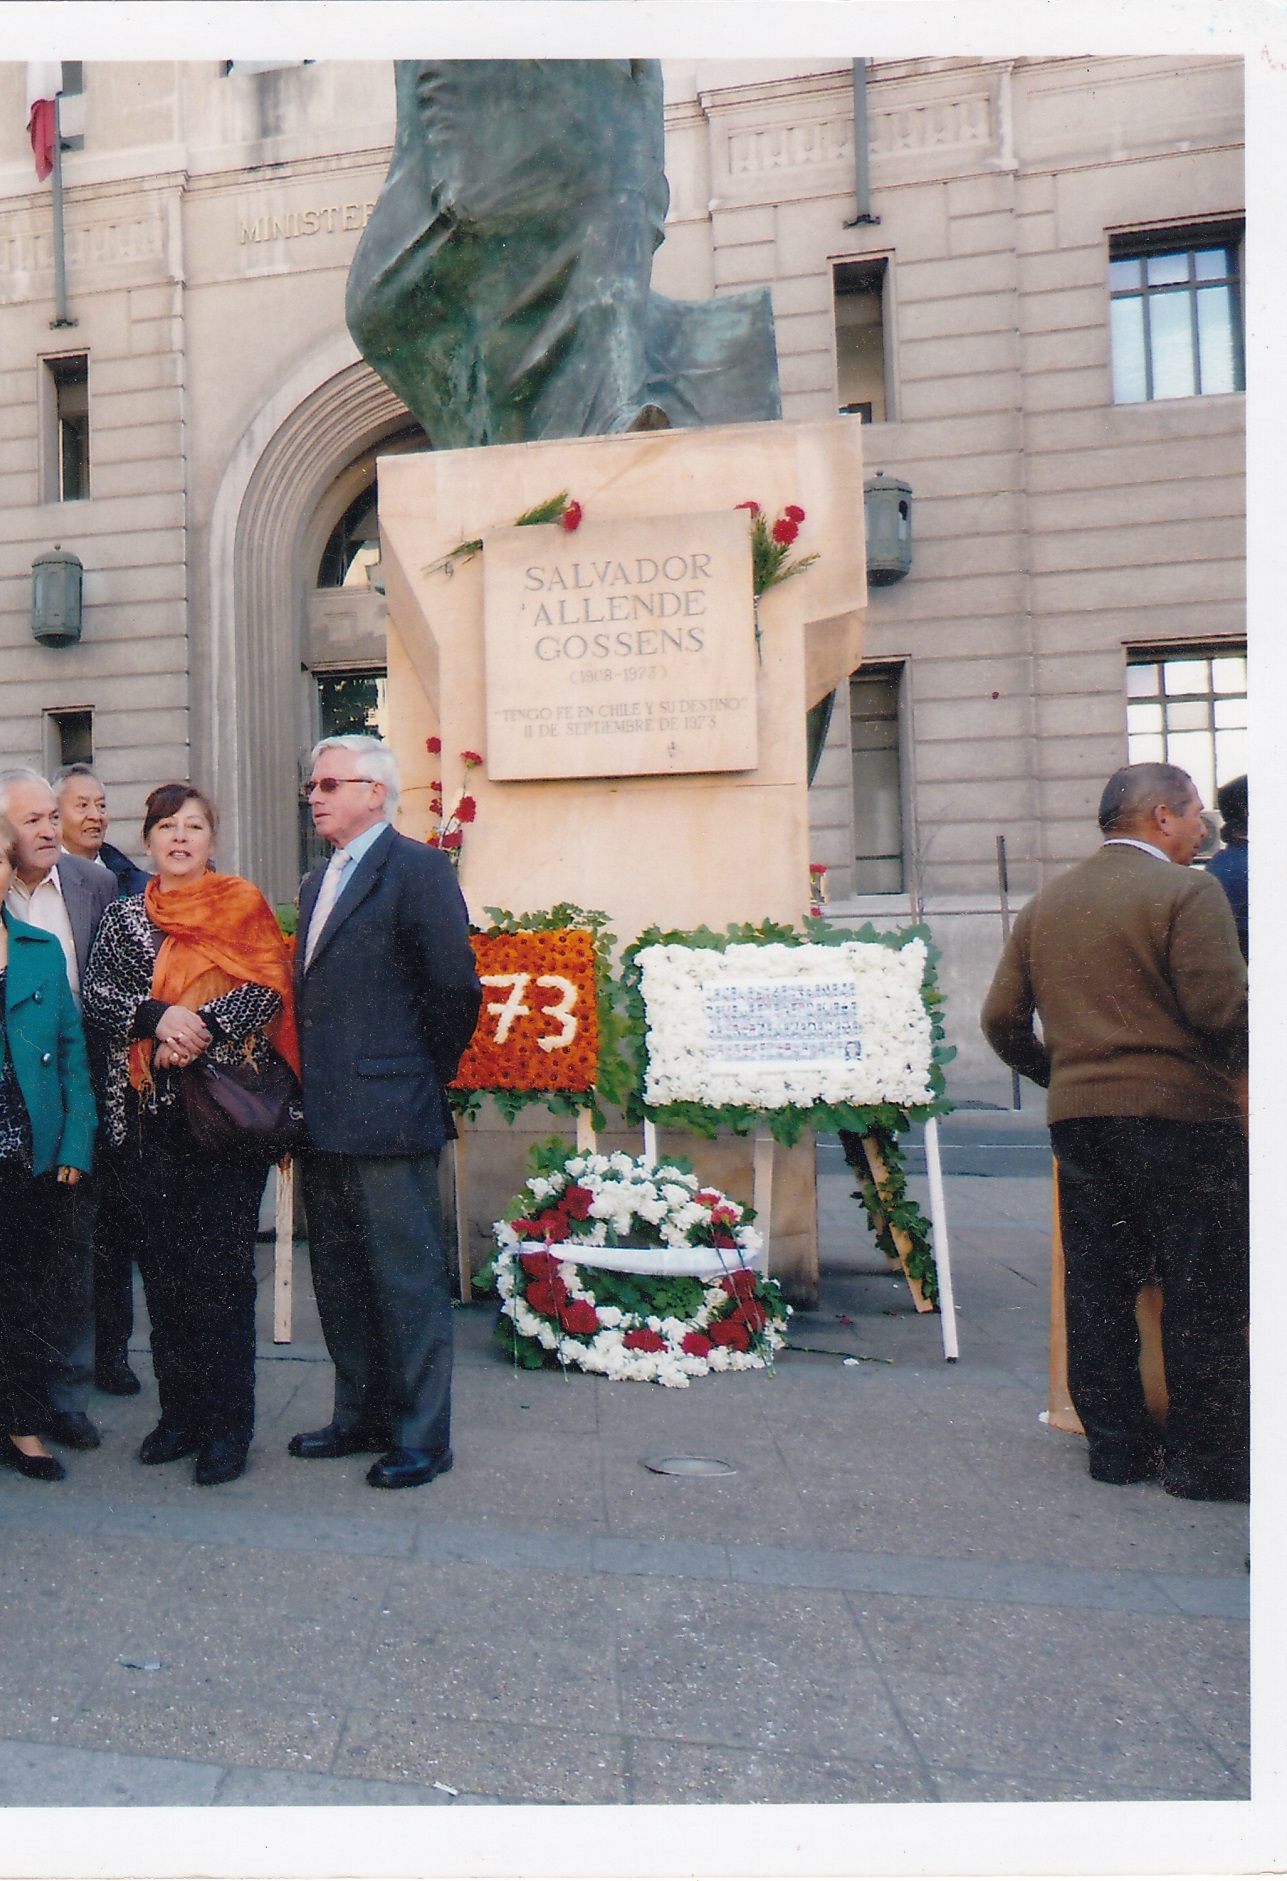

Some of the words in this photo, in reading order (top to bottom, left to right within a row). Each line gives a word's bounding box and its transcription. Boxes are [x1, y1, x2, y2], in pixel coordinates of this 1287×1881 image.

[524, 552, 712, 592] SALVADOR
[533, 589, 707, 627] ALLENDE
[534, 626, 705, 662] GOSSENS
[539, 723, 559, 738] DE
[566, 717, 652, 736] SEPTIEMBRE
[659, 716, 679, 731] DE
[684, 714, 717, 730] 1973
[556, 705, 573, 720] FE
[577, 704, 594, 719] EN
[598, 701, 640, 718] CHILE
[646, 701, 655, 715] Y
[659, 700, 676, 715] SU
[479, 972, 578, 1053] 73
